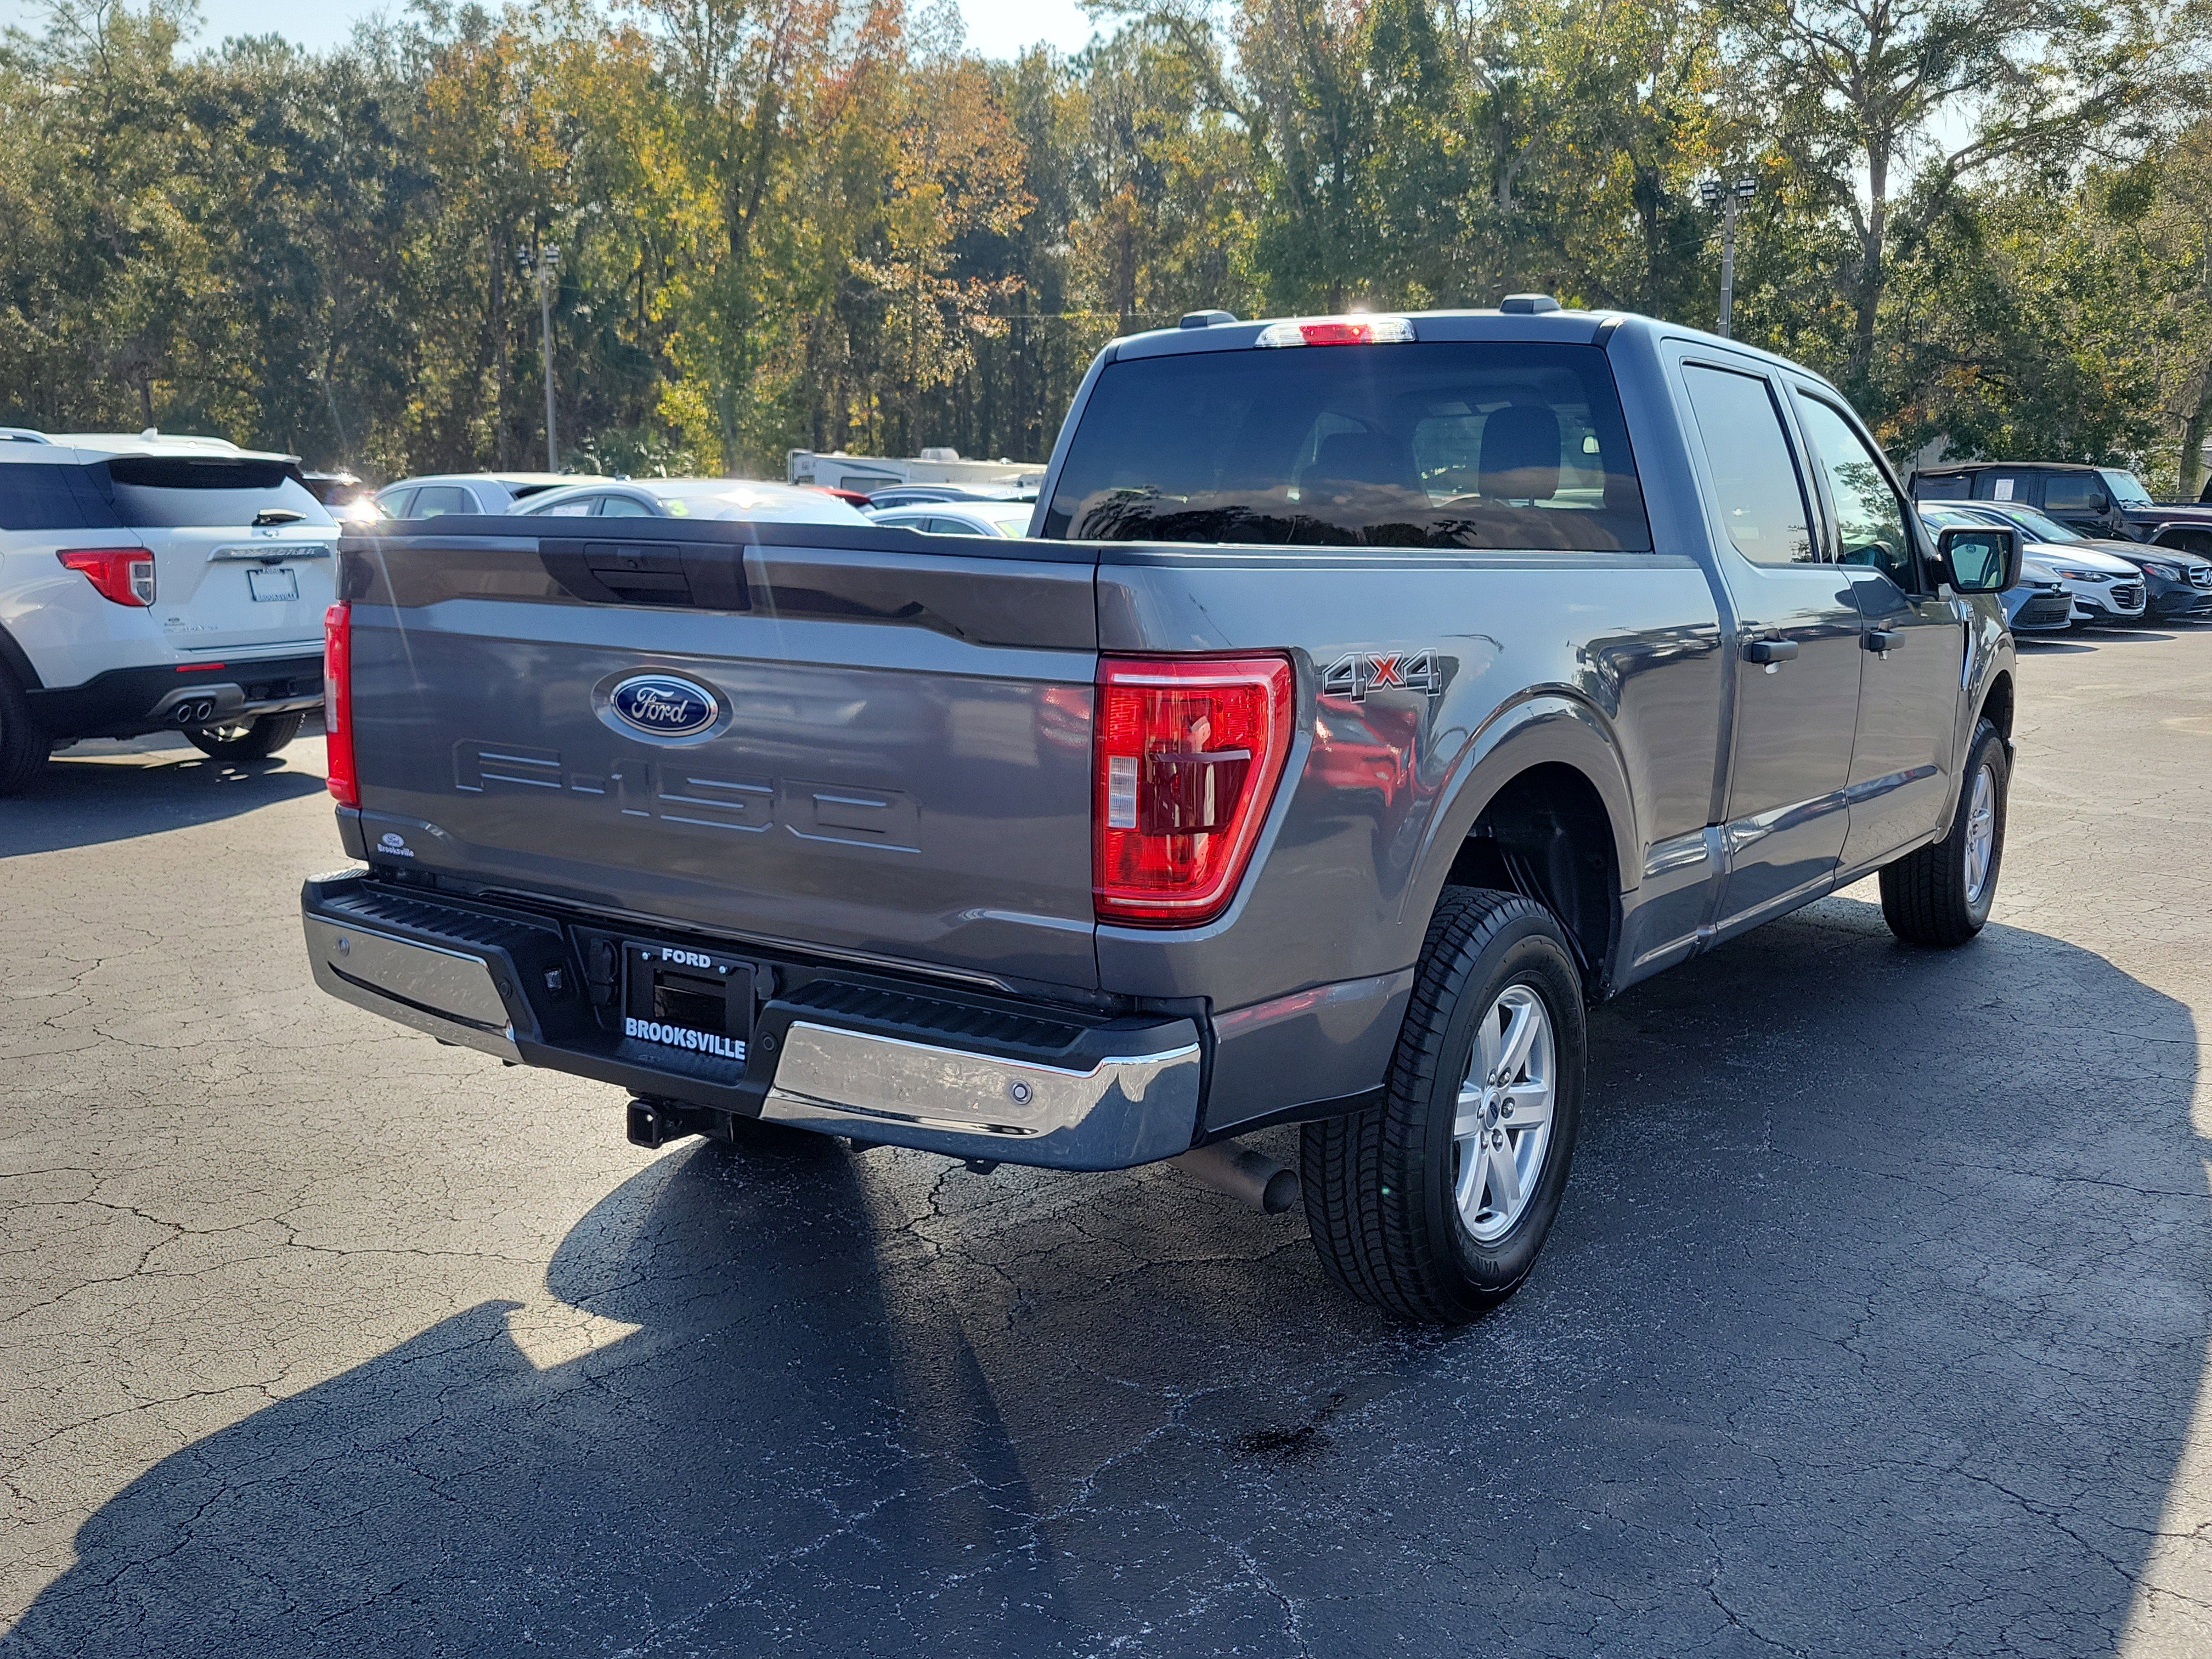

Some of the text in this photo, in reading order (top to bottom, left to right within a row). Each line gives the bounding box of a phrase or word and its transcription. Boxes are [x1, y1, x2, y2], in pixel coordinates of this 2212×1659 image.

[631, 687, 688, 723] Ford
[453, 738, 922, 853] F-150
[662, 947, 712, 968] FORD
[625, 1017, 746, 1060] BROOKSVILLE
